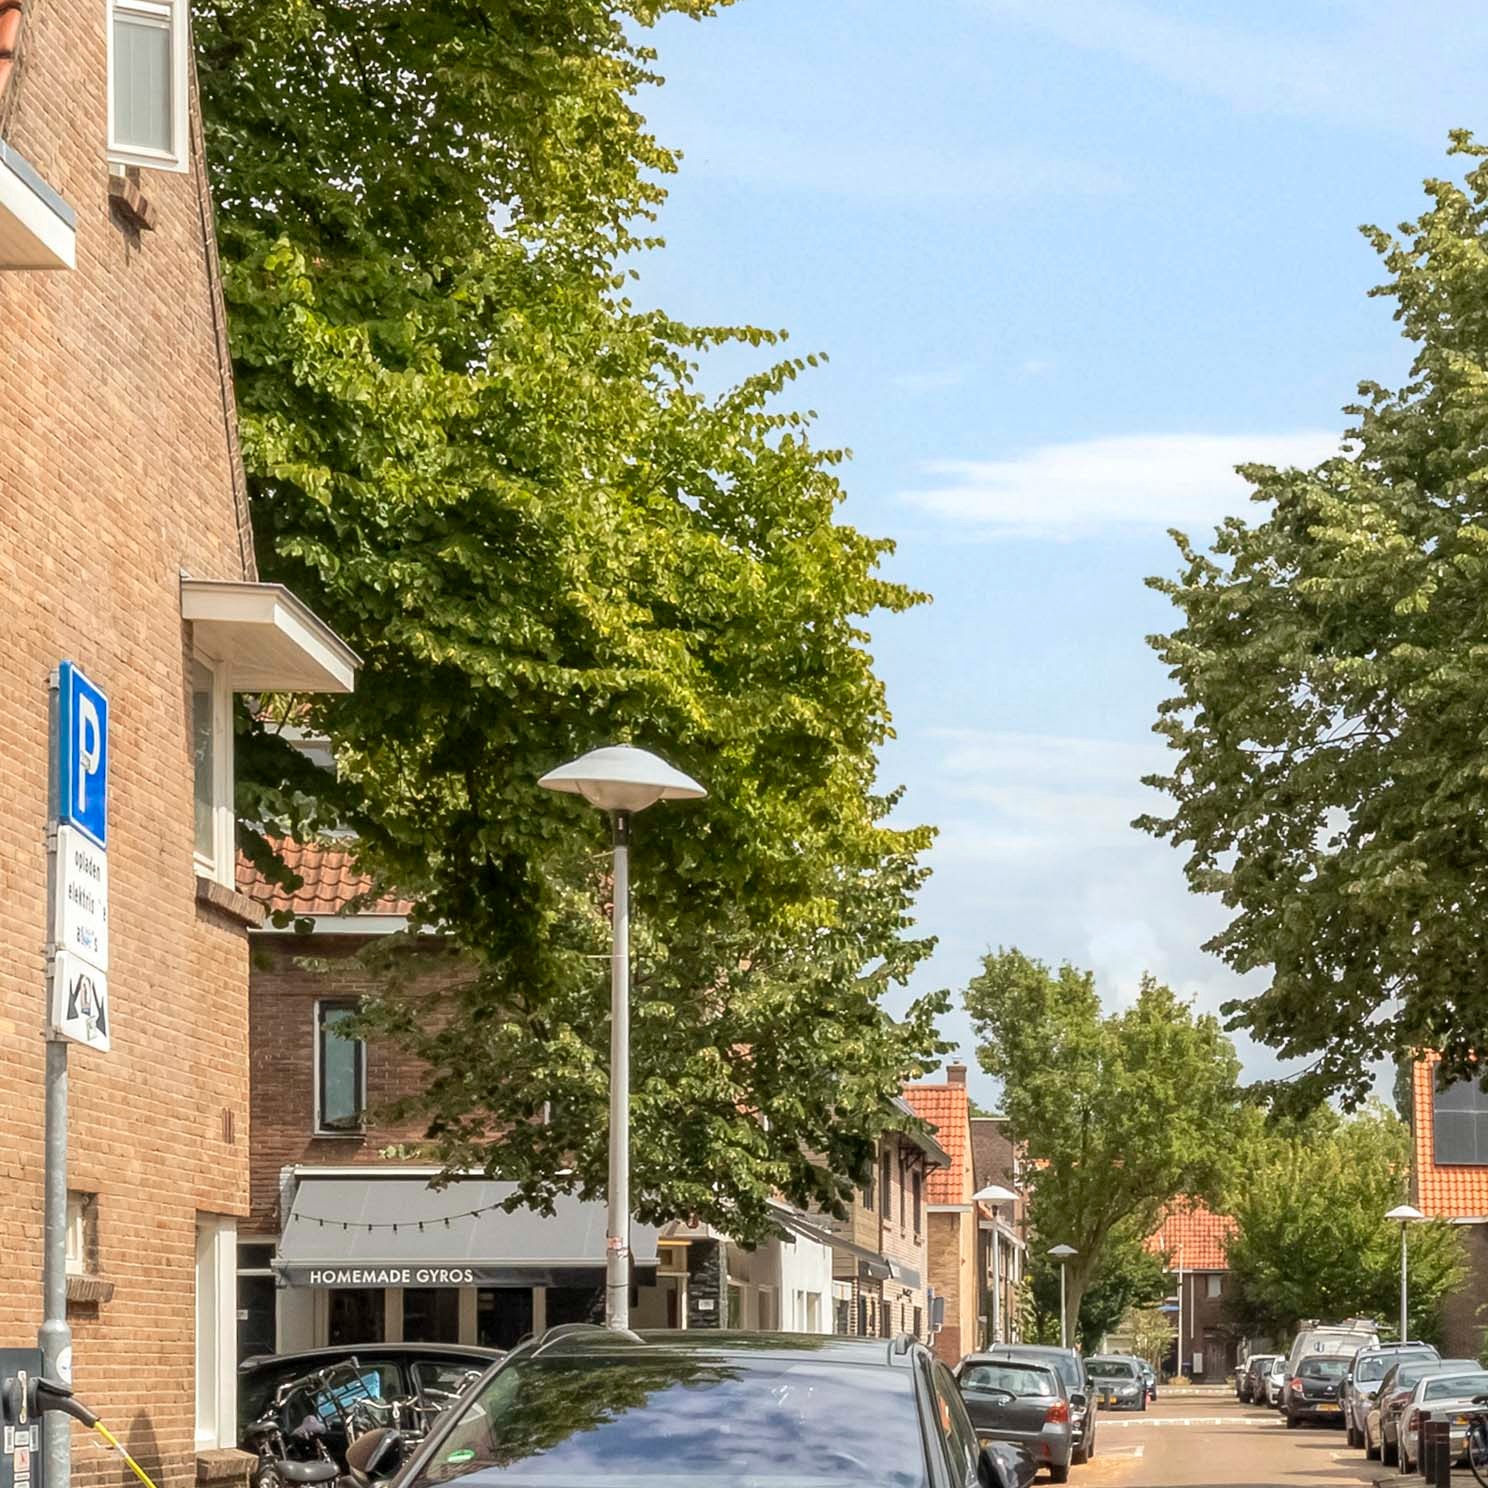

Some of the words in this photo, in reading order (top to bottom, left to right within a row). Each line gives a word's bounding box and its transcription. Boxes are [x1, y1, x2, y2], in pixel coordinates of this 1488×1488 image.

[79, 692, 101, 813] P
[74, 850, 100, 882] opladen
[68, 880, 106, 922] elektrise
[310, 1269, 411, 1284] HOMEMADE
[416, 1269, 474, 1283] GYROS
